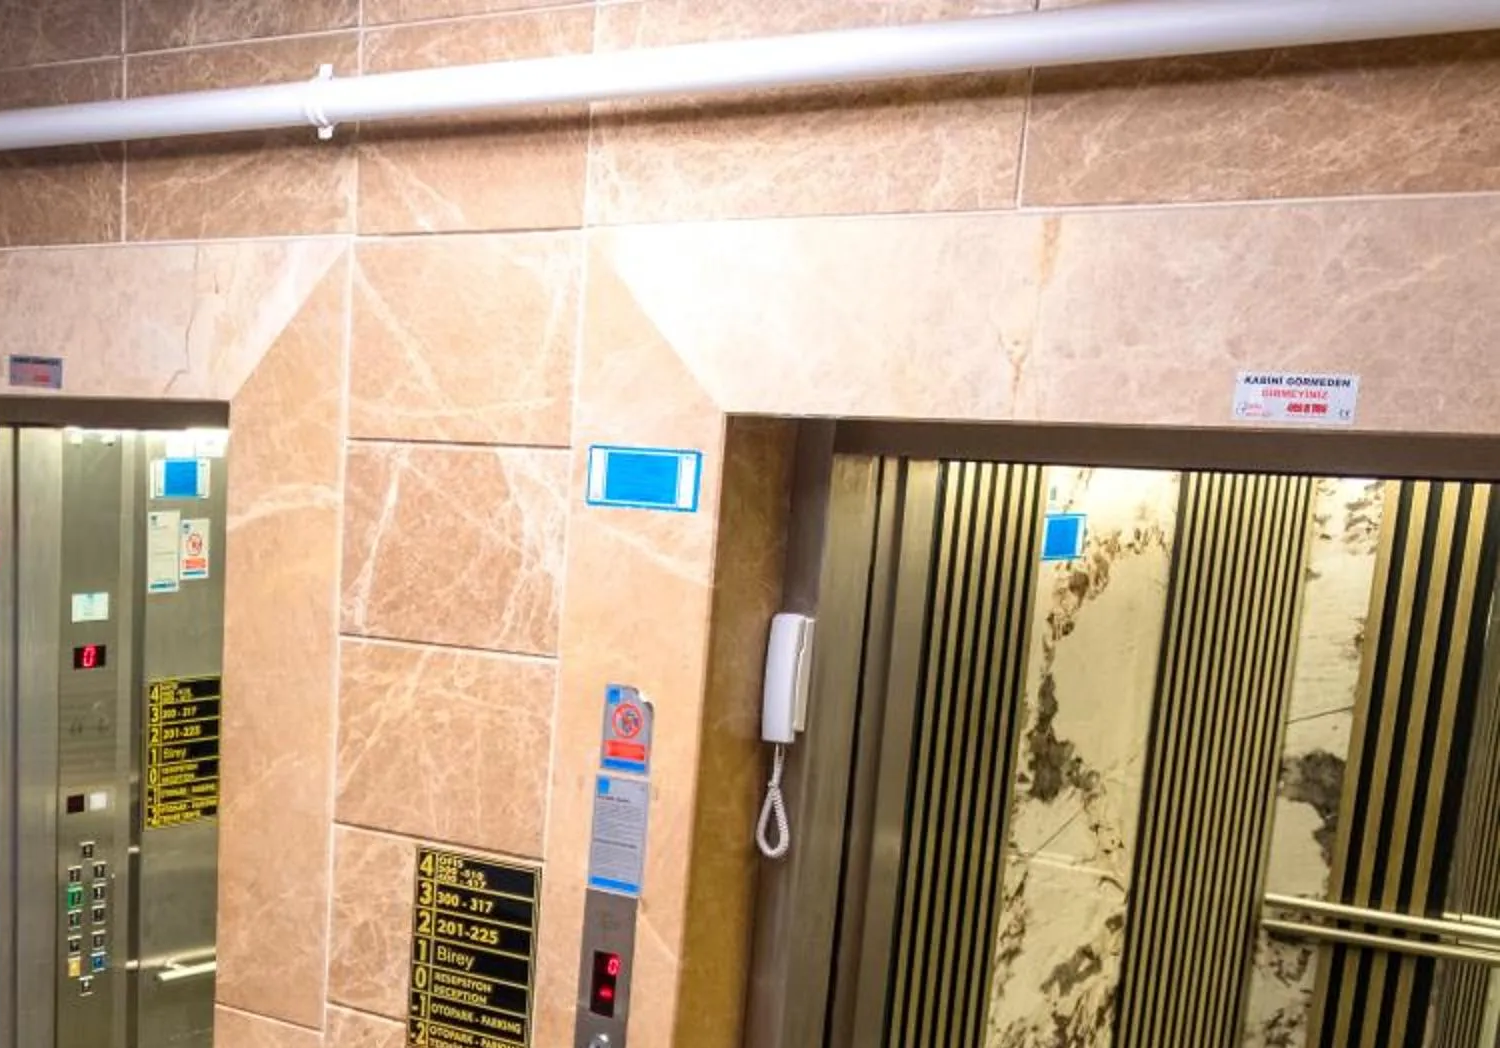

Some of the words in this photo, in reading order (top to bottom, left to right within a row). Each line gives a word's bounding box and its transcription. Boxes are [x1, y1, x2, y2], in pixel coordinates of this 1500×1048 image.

[83, 647, 96, 667] 0
[151, 707, 160, 723] 3
[151, 728, 160, 743] 2
[150, 768, 158, 784] 0
[420, 853, 434, 876] 4
[419, 881, 433, 904] 3
[437, 891, 460, 907] 300
[469, 897, 493, 914] 317
[418, 911, 431, 934] 2
[417, 939, 427, 960] 1
[436, 945, 476, 971] Birey
[607, 957, 619, 975] 0
[415, 966, 427, 988] 0
[431, 1003, 473, 1022] OTOPARK
[481, 1014, 521, 1035] PARKING
[429, 1025, 473, 1043] OTOPARK
